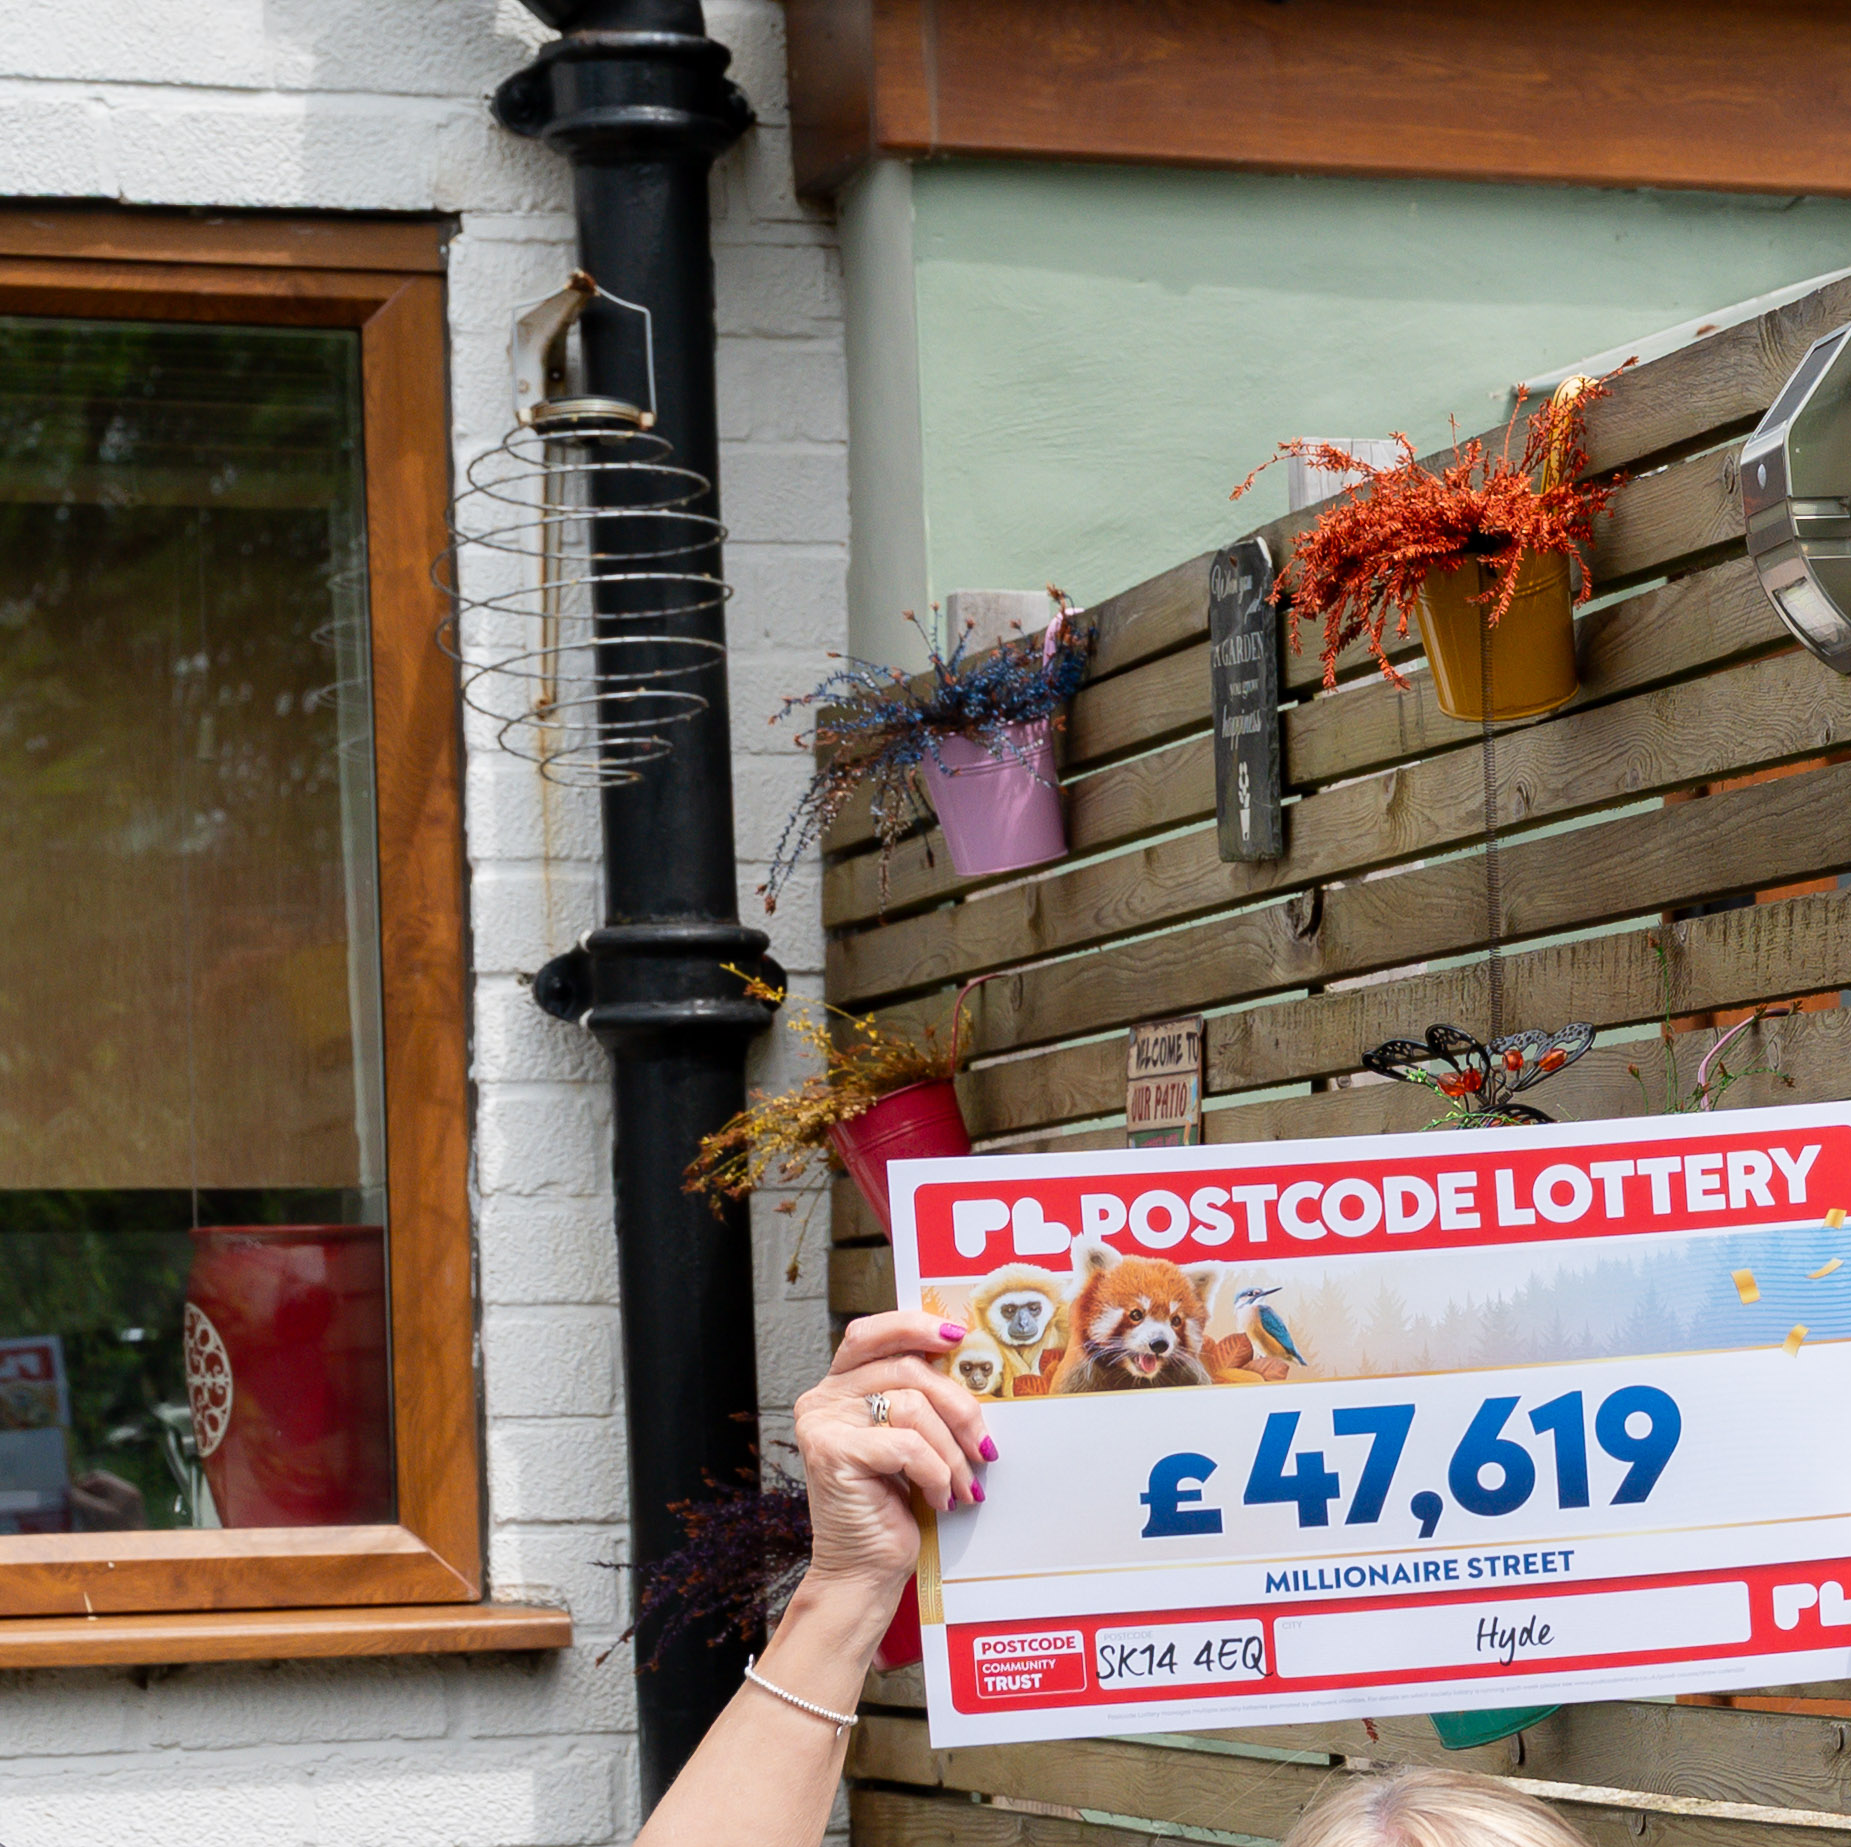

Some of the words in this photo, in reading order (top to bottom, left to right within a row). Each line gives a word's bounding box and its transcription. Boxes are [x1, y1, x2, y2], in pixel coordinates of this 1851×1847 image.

[1221, 631, 1265, 667] GARDEN
[1186, 1031, 1199, 1064] TO
[1131, 1085, 1151, 1123] OUR
[1153, 1081, 1188, 1120] PATIO
[1080, 1171, 1481, 1250] POSTCODE
[1495, 1144, 1822, 1227] LOTTERY
[1265, 1559, 1460, 1594] MILLIONAIRE
[1467, 1550, 1576, 1579] STREET
[980, 1635, 1077, 1656] POSTCODE
[1095, 1642, 1178, 1680] SK14
[1193, 1635, 1275, 1678] 4EQ
[1476, 1616, 1556, 1666] Hyde
[982, 1658, 1056, 1675] COMMUNITY
[984, 1672, 1042, 1693] TRUST
